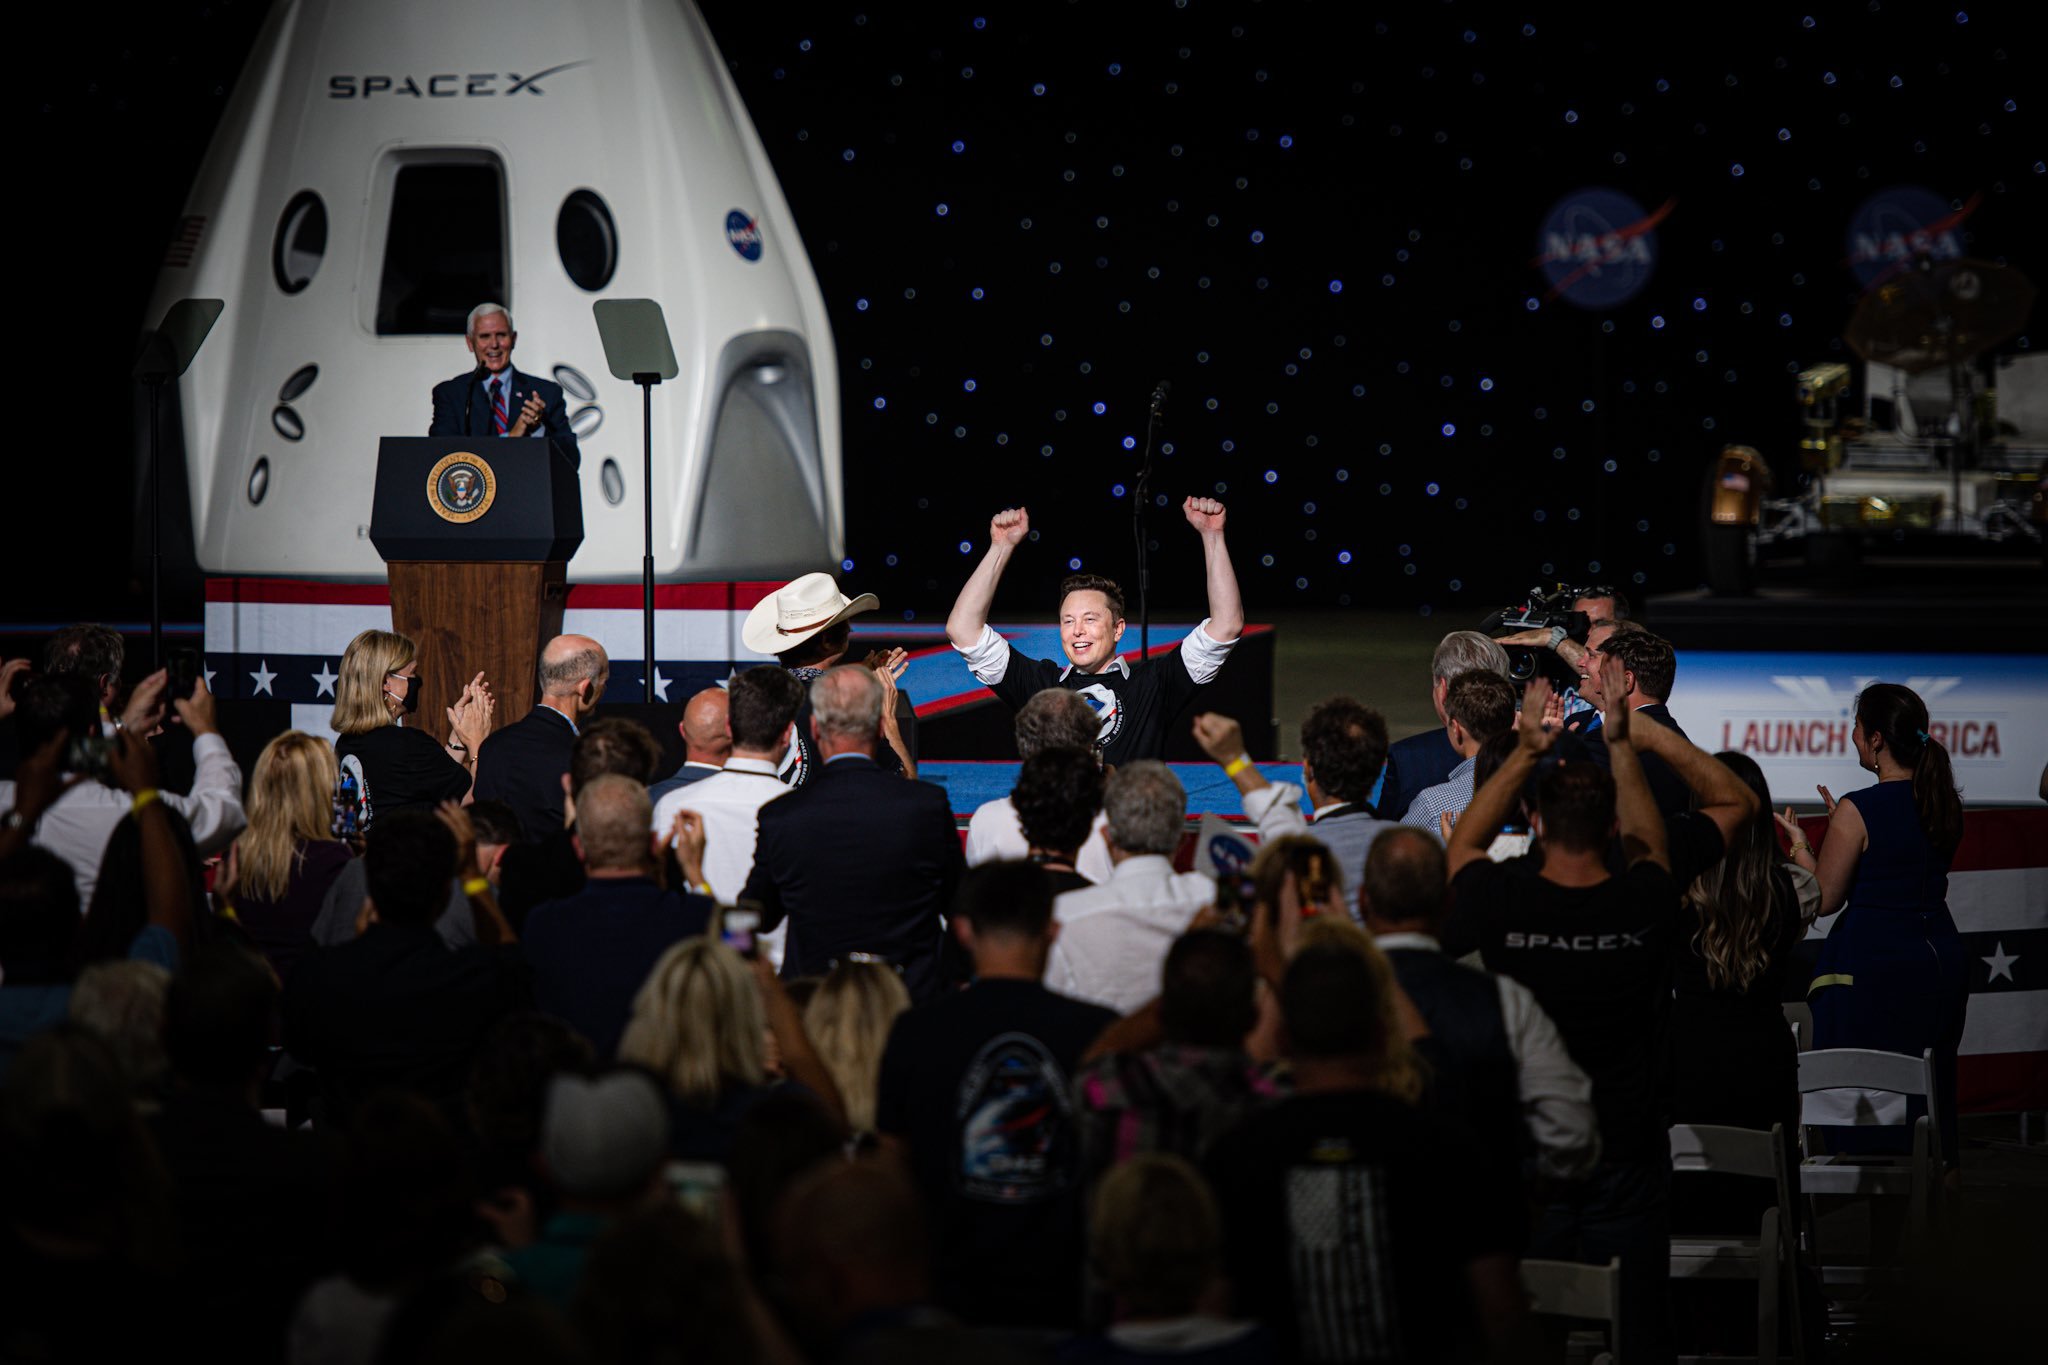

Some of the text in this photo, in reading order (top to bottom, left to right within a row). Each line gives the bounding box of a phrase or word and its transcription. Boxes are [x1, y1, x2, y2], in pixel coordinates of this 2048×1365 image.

[328, 58, 594, 99] SPACEX
[1545, 232, 1651, 264] NASA
[1855, 232, 1961, 261] NASA
[1722, 721, 2000, 756] LAUNCH RICA
[1504, 923, 1656, 951] SPACEX
